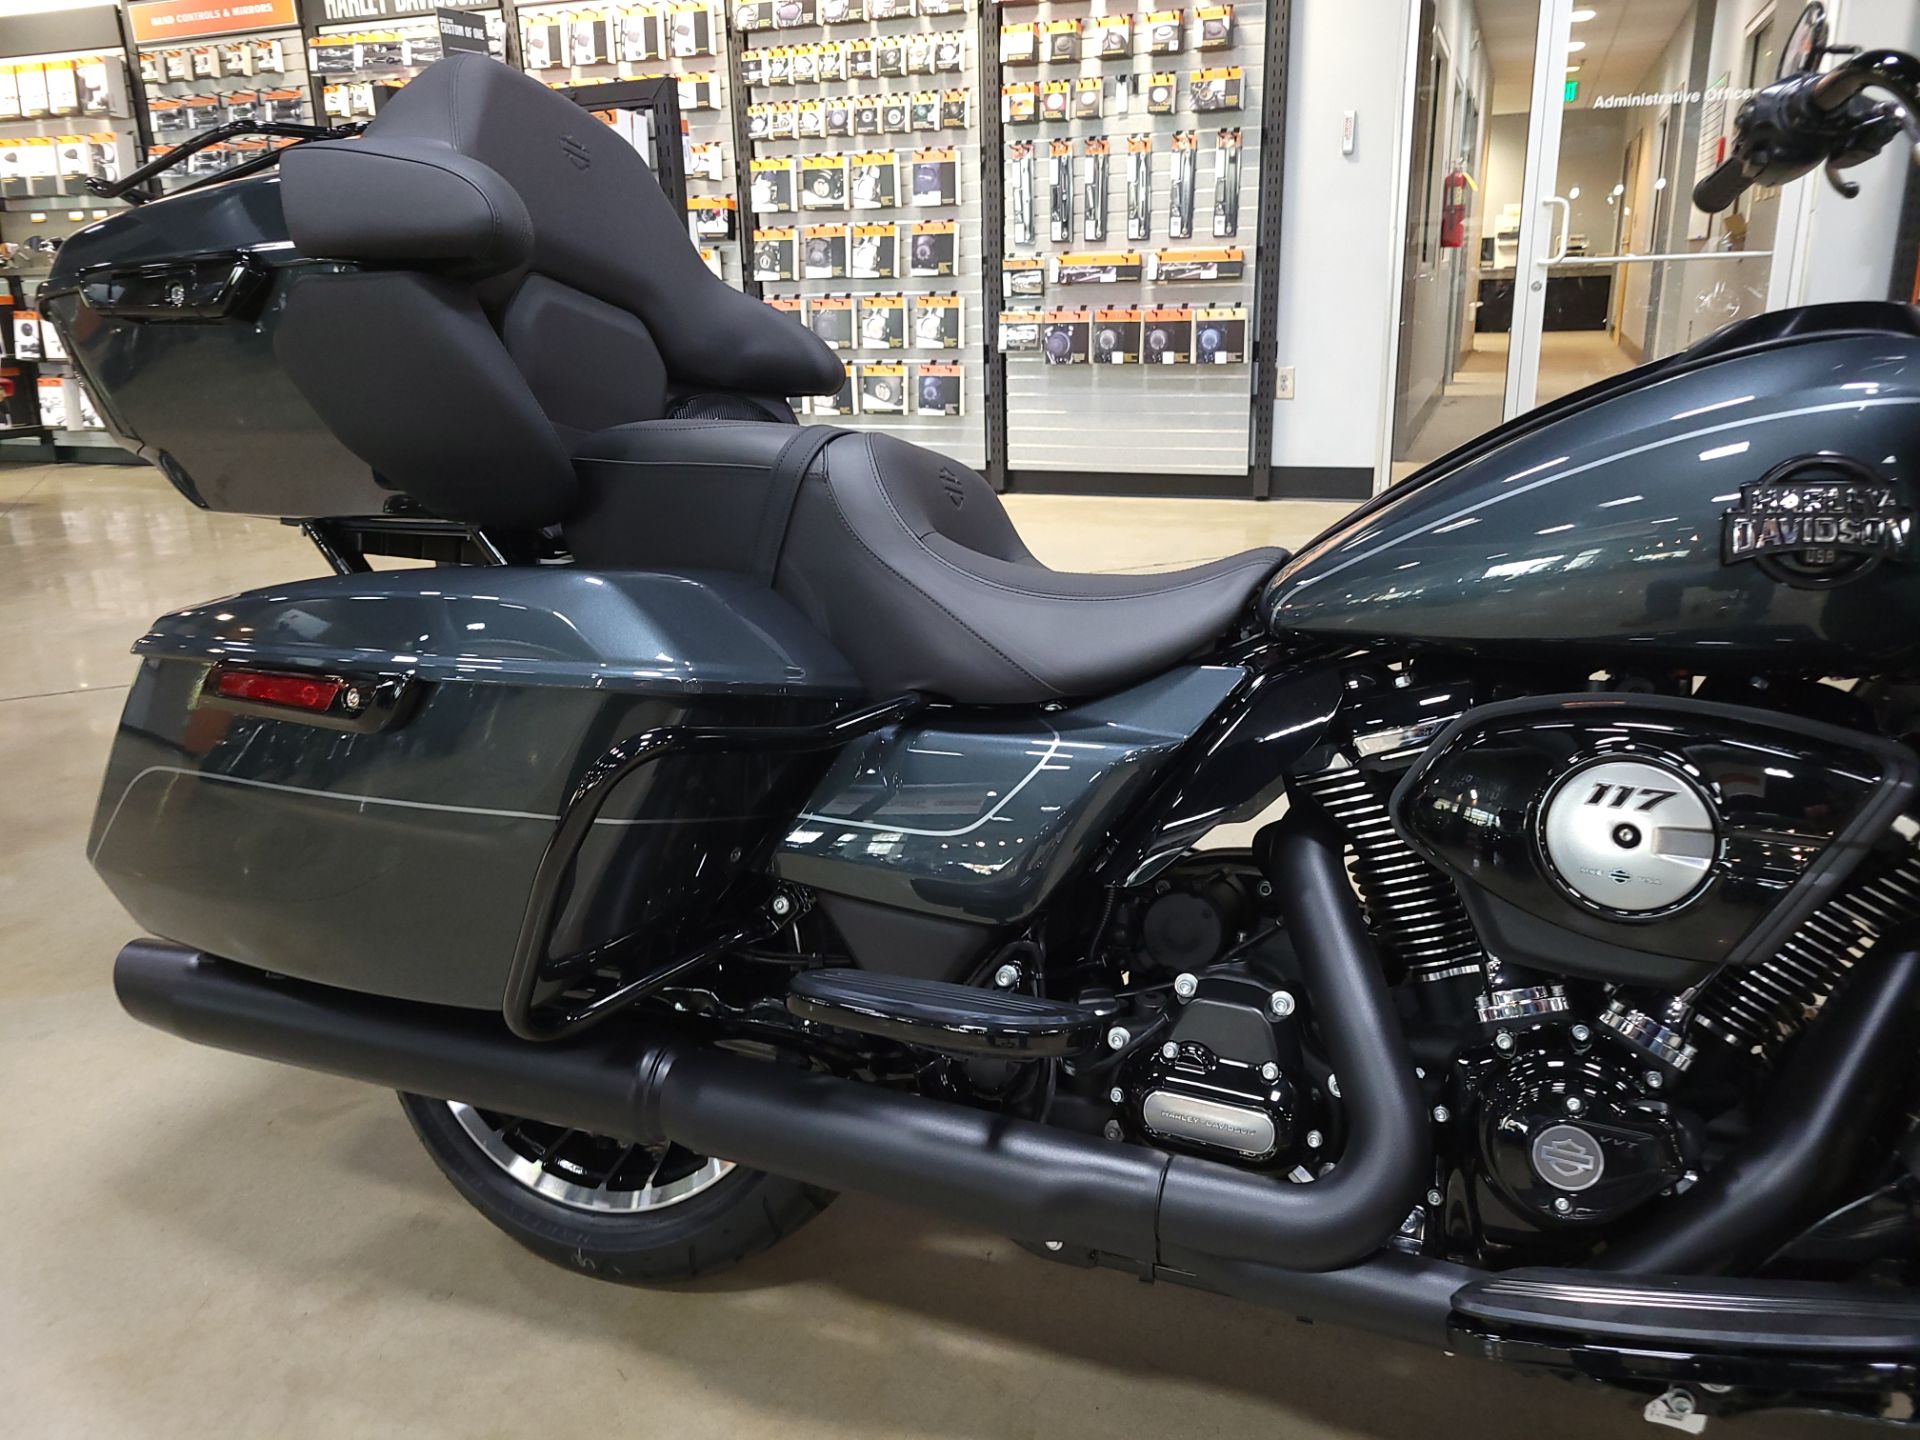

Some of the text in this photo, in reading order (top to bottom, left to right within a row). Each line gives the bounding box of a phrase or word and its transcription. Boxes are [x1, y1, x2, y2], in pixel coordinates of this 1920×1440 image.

[151, 3, 273, 26] HAND CONTROLS & MIRRORS
[440, 22, 485, 40] CUSTOM OF ONE
[1593, 90, 1701, 109] Administrative
[1752, 488, 1896, 514] HARLEY
[1732, 517, 1910, 554] DAVIDSON
[1805, 550, 1836, 564] USA
[1584, 782, 1682, 813] 117
